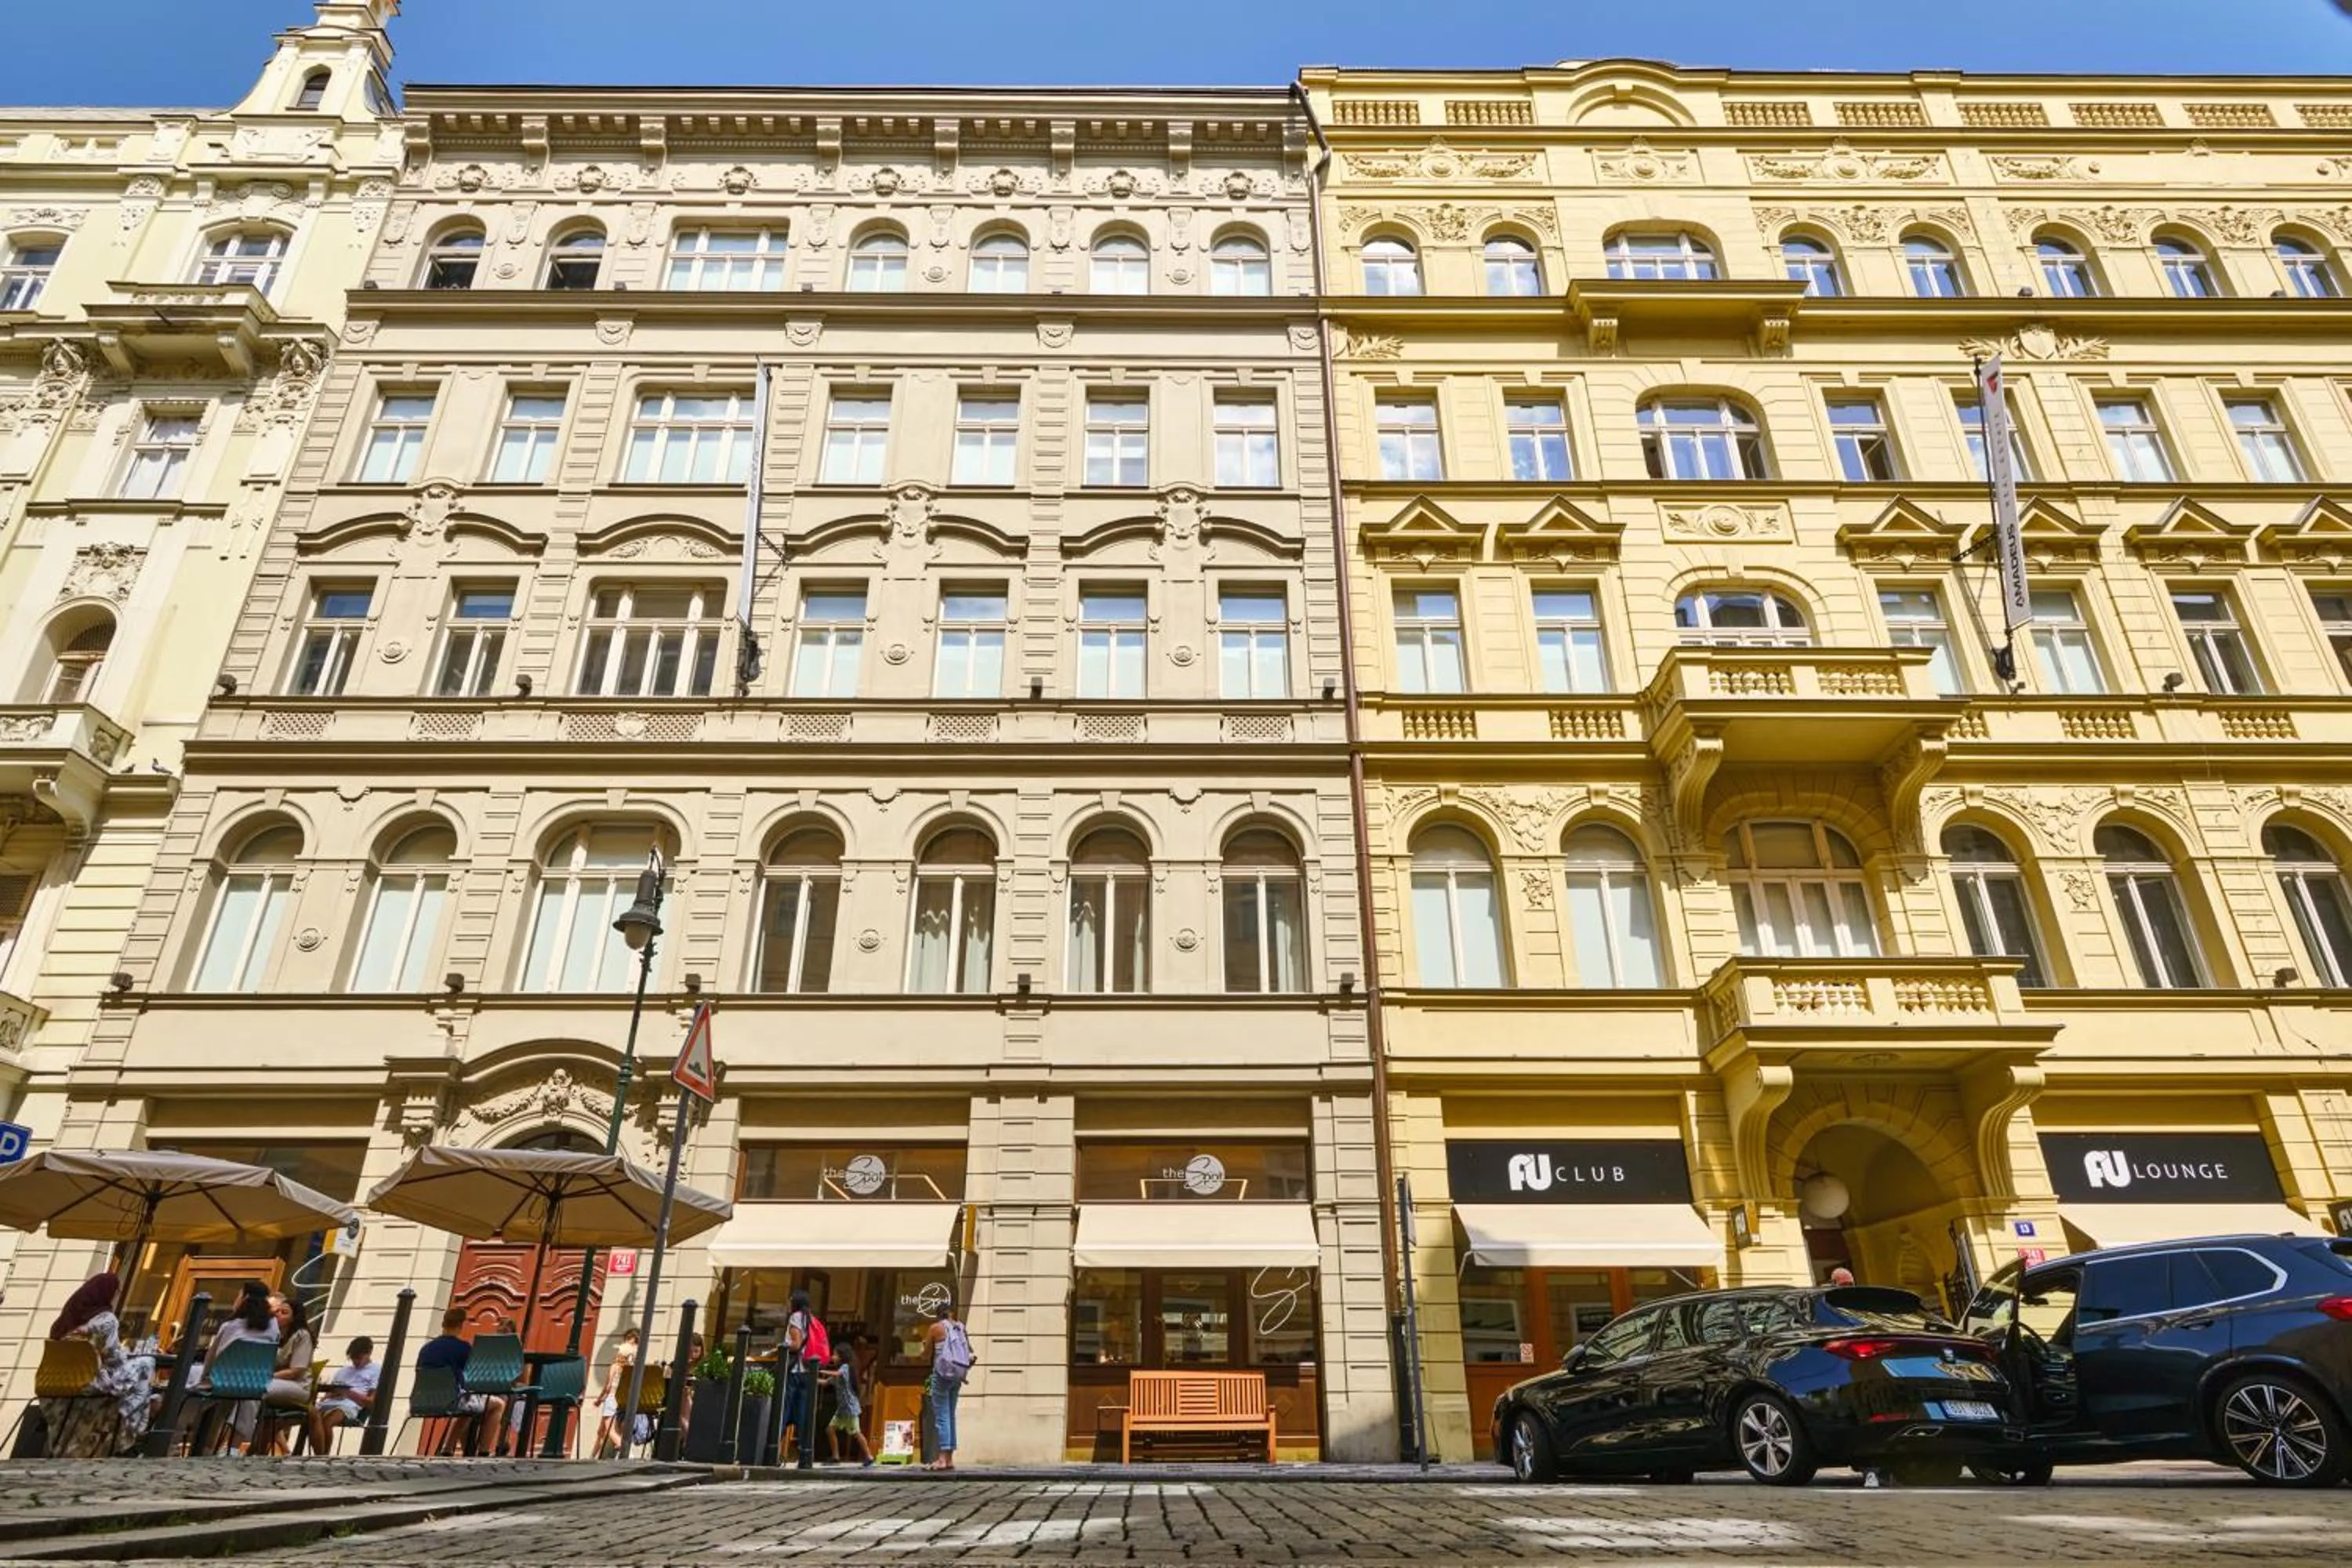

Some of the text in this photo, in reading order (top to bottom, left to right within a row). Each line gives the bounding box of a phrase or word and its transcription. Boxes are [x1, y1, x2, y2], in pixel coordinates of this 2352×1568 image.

[2007, 523, 2024, 607] AMADEUS
[824, 1167, 845, 1178] the
[1163, 1167, 1185, 1179] the
[1555, 1166, 1625, 1181] CLUB
[2132, 1163, 2229, 1179] LOUNGE
[900, 1294, 919, 1305] the
